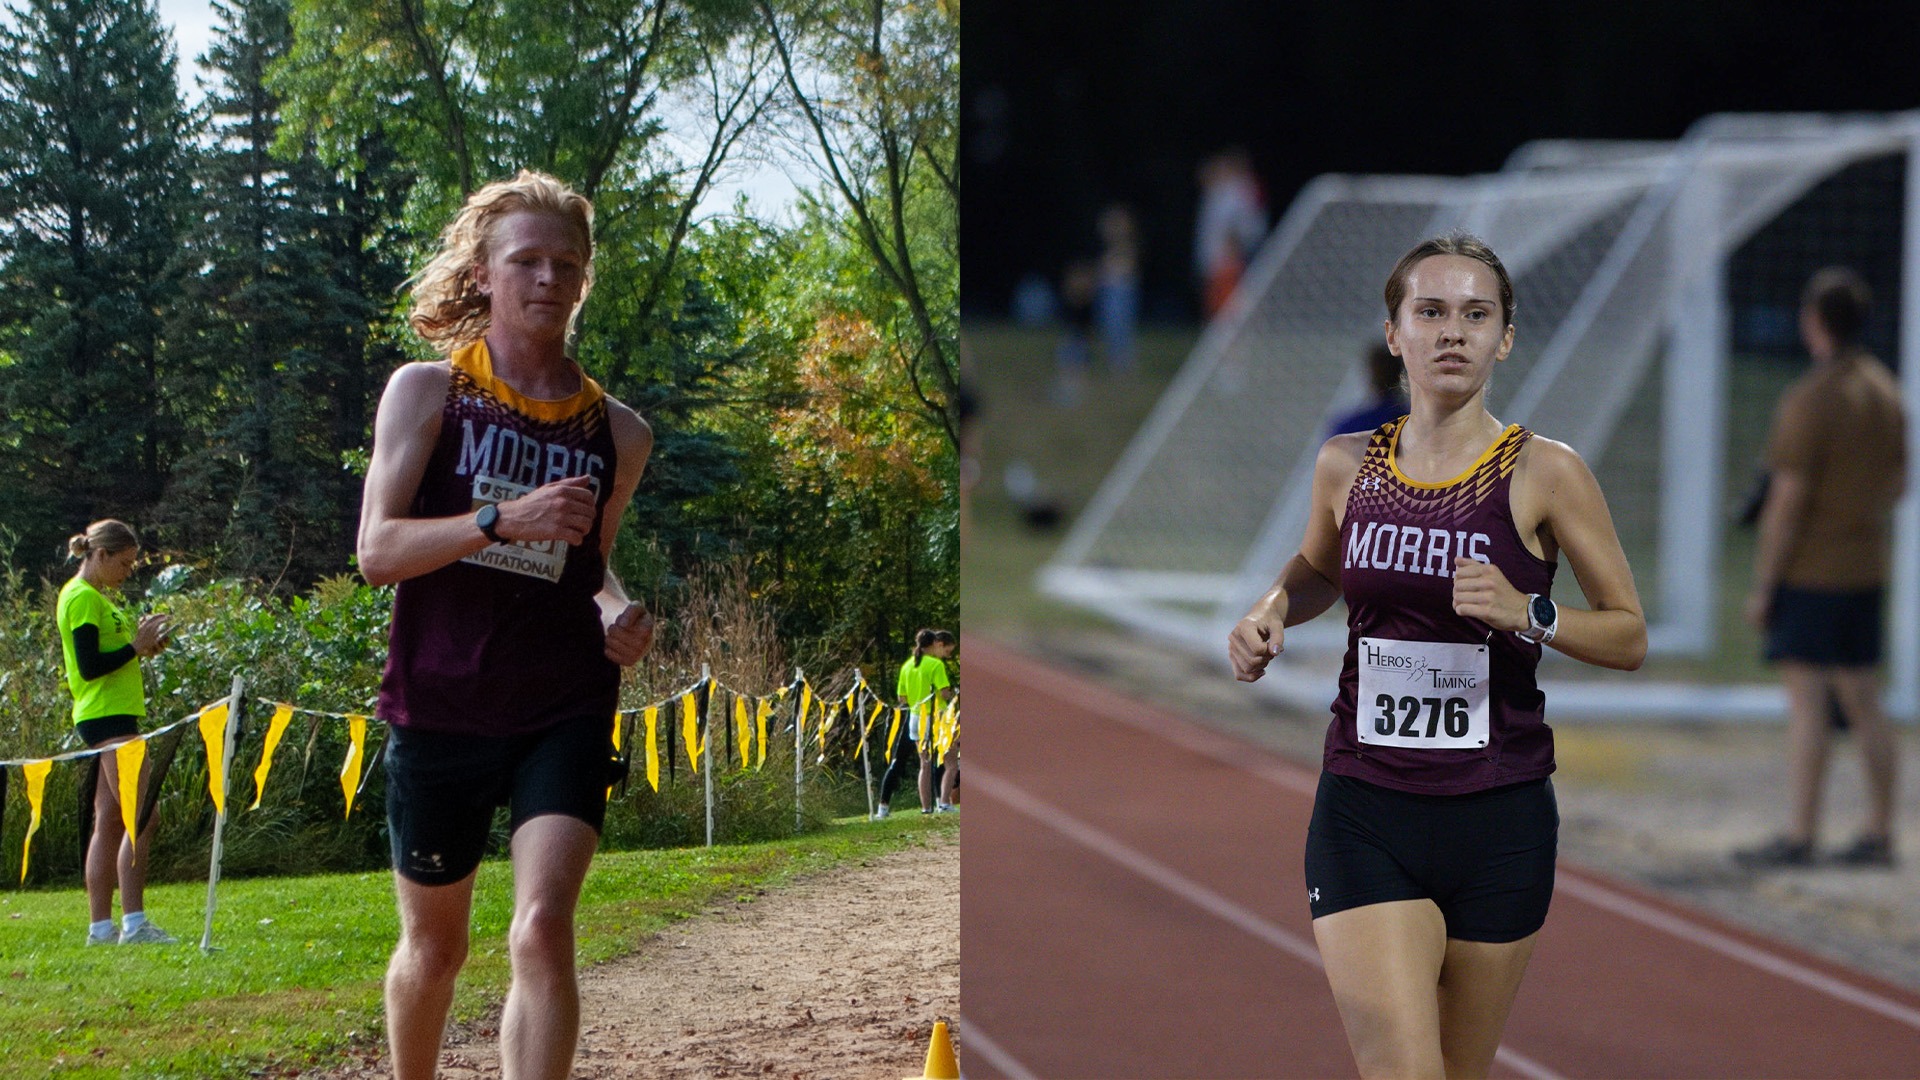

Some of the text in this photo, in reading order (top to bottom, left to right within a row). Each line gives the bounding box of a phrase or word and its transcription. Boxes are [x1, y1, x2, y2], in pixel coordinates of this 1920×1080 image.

[456, 419, 605, 503] MORRIS
[468, 547, 556, 578] NVITATIONAL
[1345, 522, 1491, 578] MORRIS
[1367, 645, 1412, 668] HERO'S
[1428, 668, 1477, 689] TIMING
[1374, 693, 1470, 738] 3276
